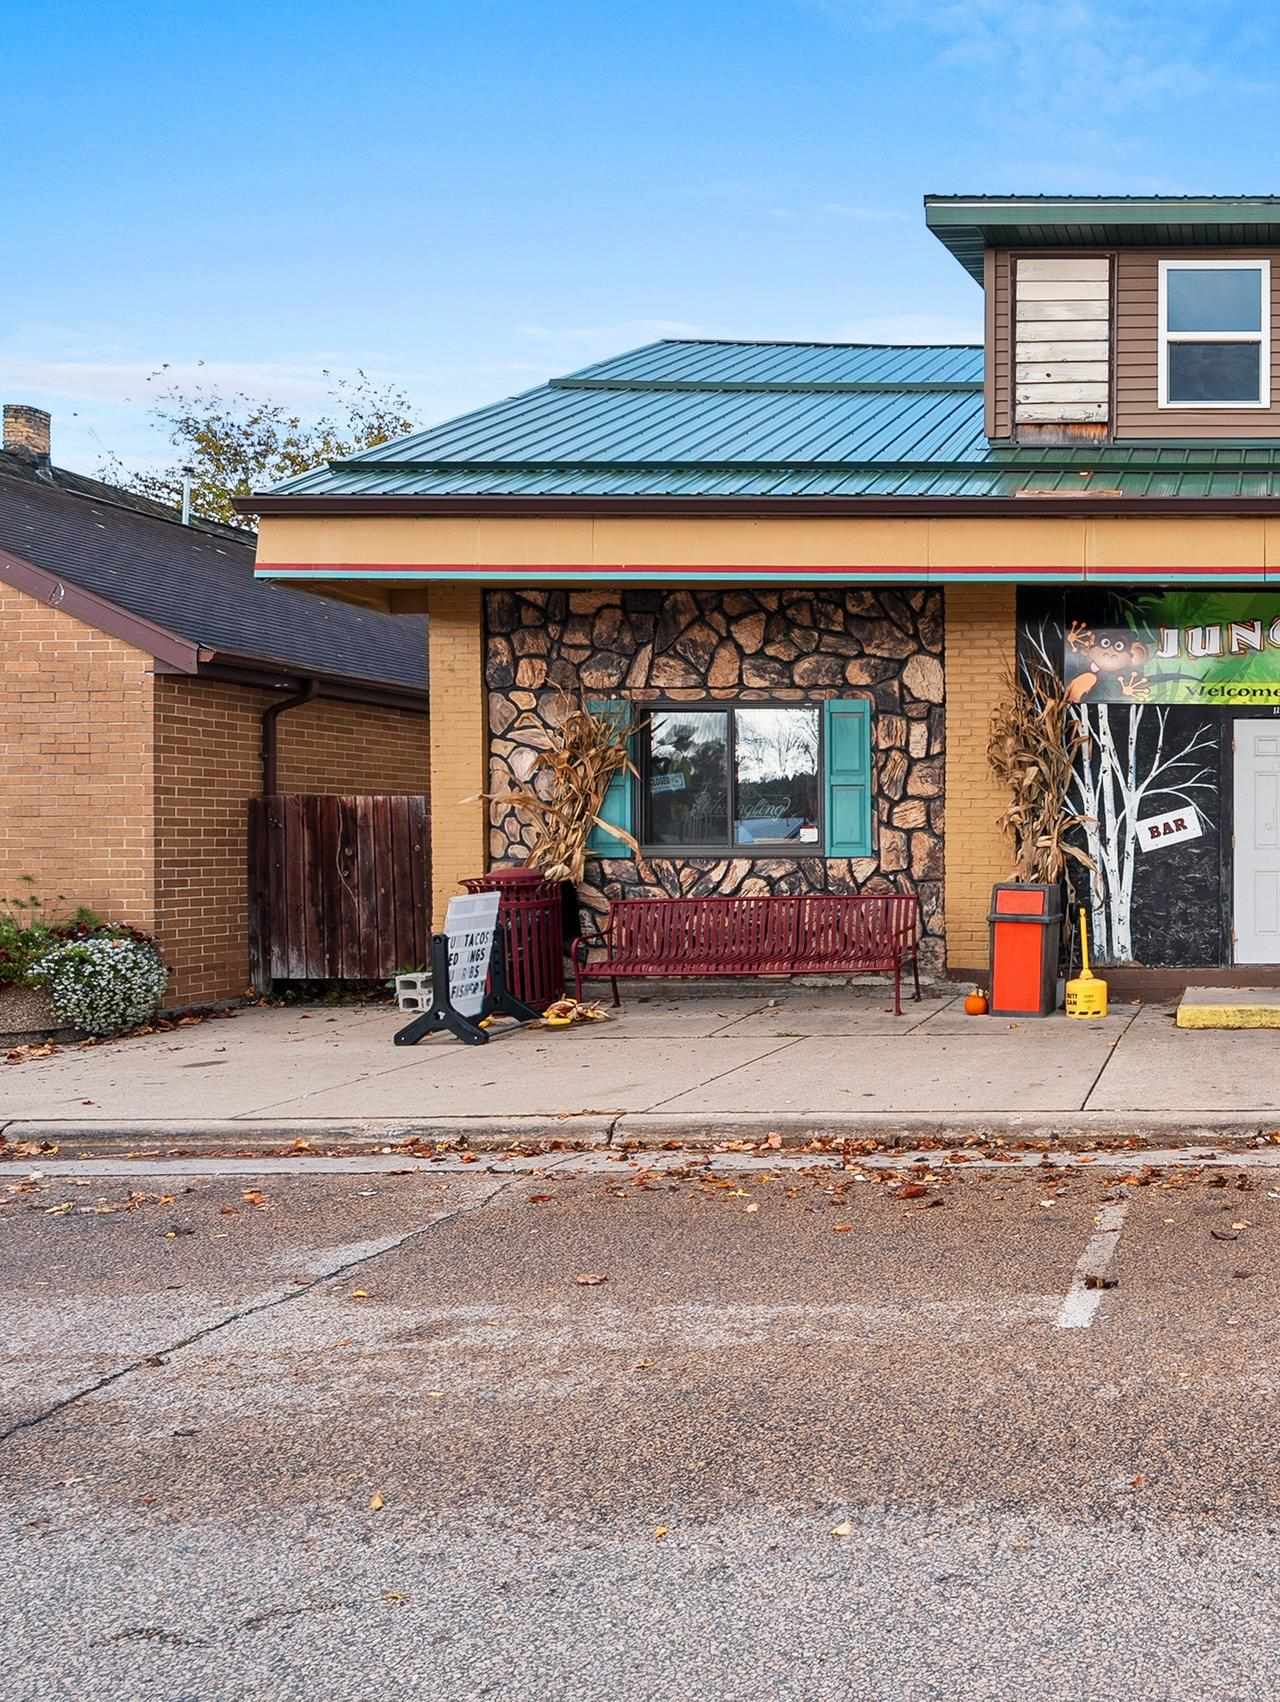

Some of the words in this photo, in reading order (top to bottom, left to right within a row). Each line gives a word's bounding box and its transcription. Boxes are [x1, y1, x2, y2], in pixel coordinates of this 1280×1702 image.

[1148, 818, 1188, 839] BAR
[464, 931, 489, 947] TACOS
[449, 952, 459, 967] ED
